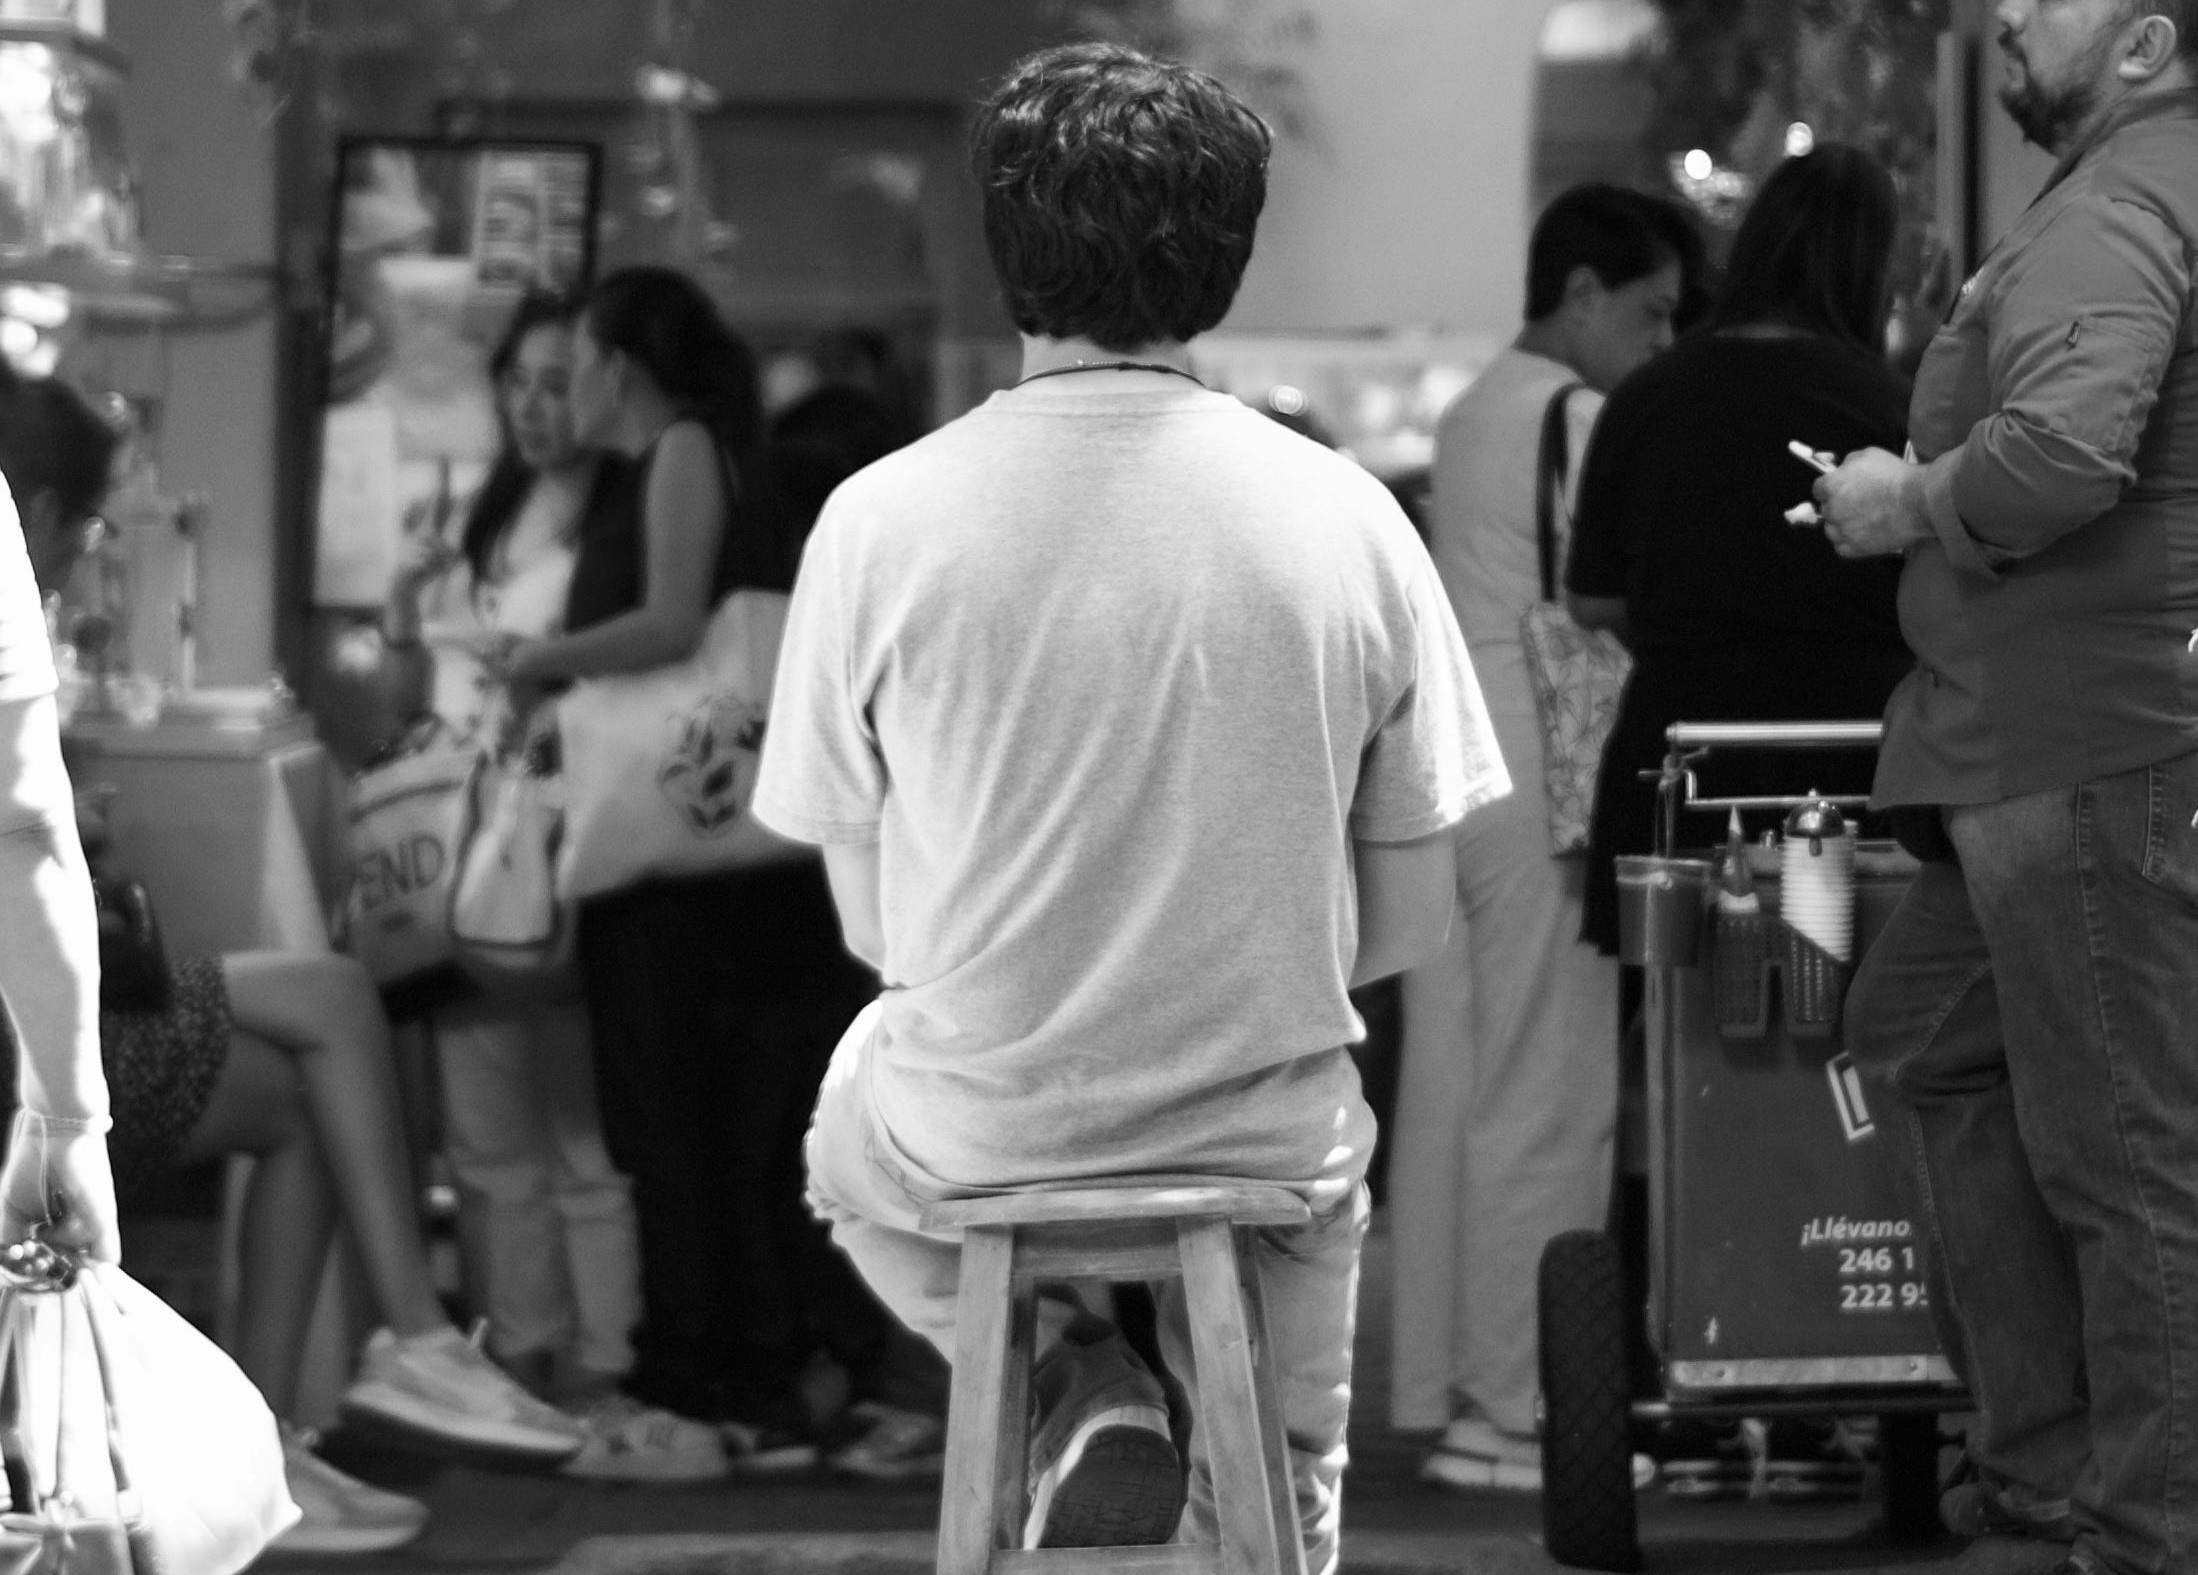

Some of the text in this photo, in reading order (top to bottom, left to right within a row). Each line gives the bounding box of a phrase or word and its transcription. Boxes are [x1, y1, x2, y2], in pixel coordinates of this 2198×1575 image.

[1840, 1247, 1914, 1273] 246 1
[1841, 1283, 1893, 1309] 222
